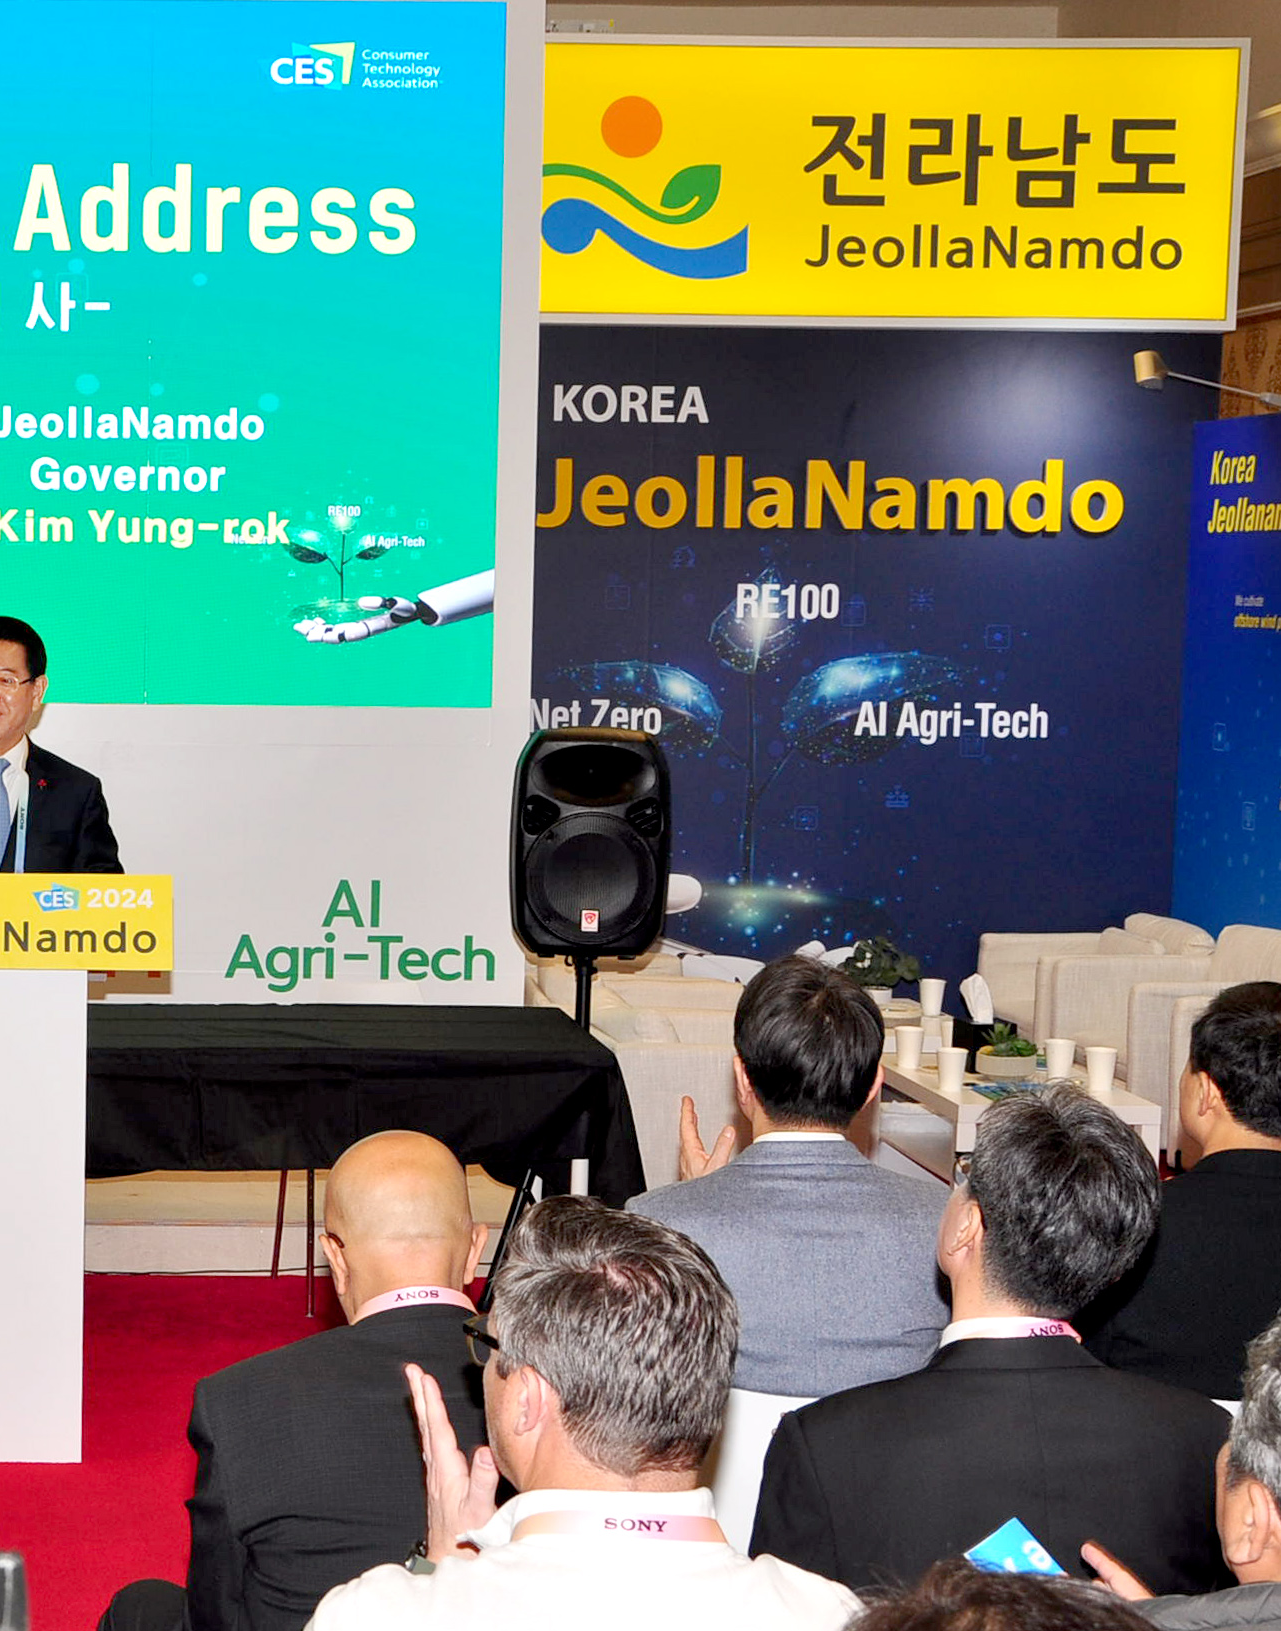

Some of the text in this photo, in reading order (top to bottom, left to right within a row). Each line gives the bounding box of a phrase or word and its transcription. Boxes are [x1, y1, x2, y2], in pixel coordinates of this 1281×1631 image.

[270, 57, 335, 85] CES
[362, 49, 430, 61] Consumer
[363, 63, 441, 78] Technology
[362, 77, 439, 89] Association
[803, 113, 1186, 208] 전라남도
[13, 163, 416, 255] Address
[804, 224, 1183, 271] JeollaNamdo
[553, 384, 709, 423] KOREA
[30, 456, 226, 492] Governor
[1210, 450, 1257, 485] Korea
[328, 505, 361, 518] RE100
[535, 456, 1124, 534] JeollaNamdo
[88, 509, 290, 549] Yung-rok
[377, 535, 425, 549] Agri-Tech
[736, 582, 839, 620] RE100
[530, 699, 662, 735] Net Zero
[854, 702, 1048, 745] AI Agri-Tech
[39, 888, 154, 909] CES 2024
[321, 880, 381, 928] AI
[225, 933, 496, 993] Agri-Tech
[394, 1288, 440, 1303] SONY
[1029, 1323, 1065, 1337] SONY
[603, 1516, 668, 1533] SONY
